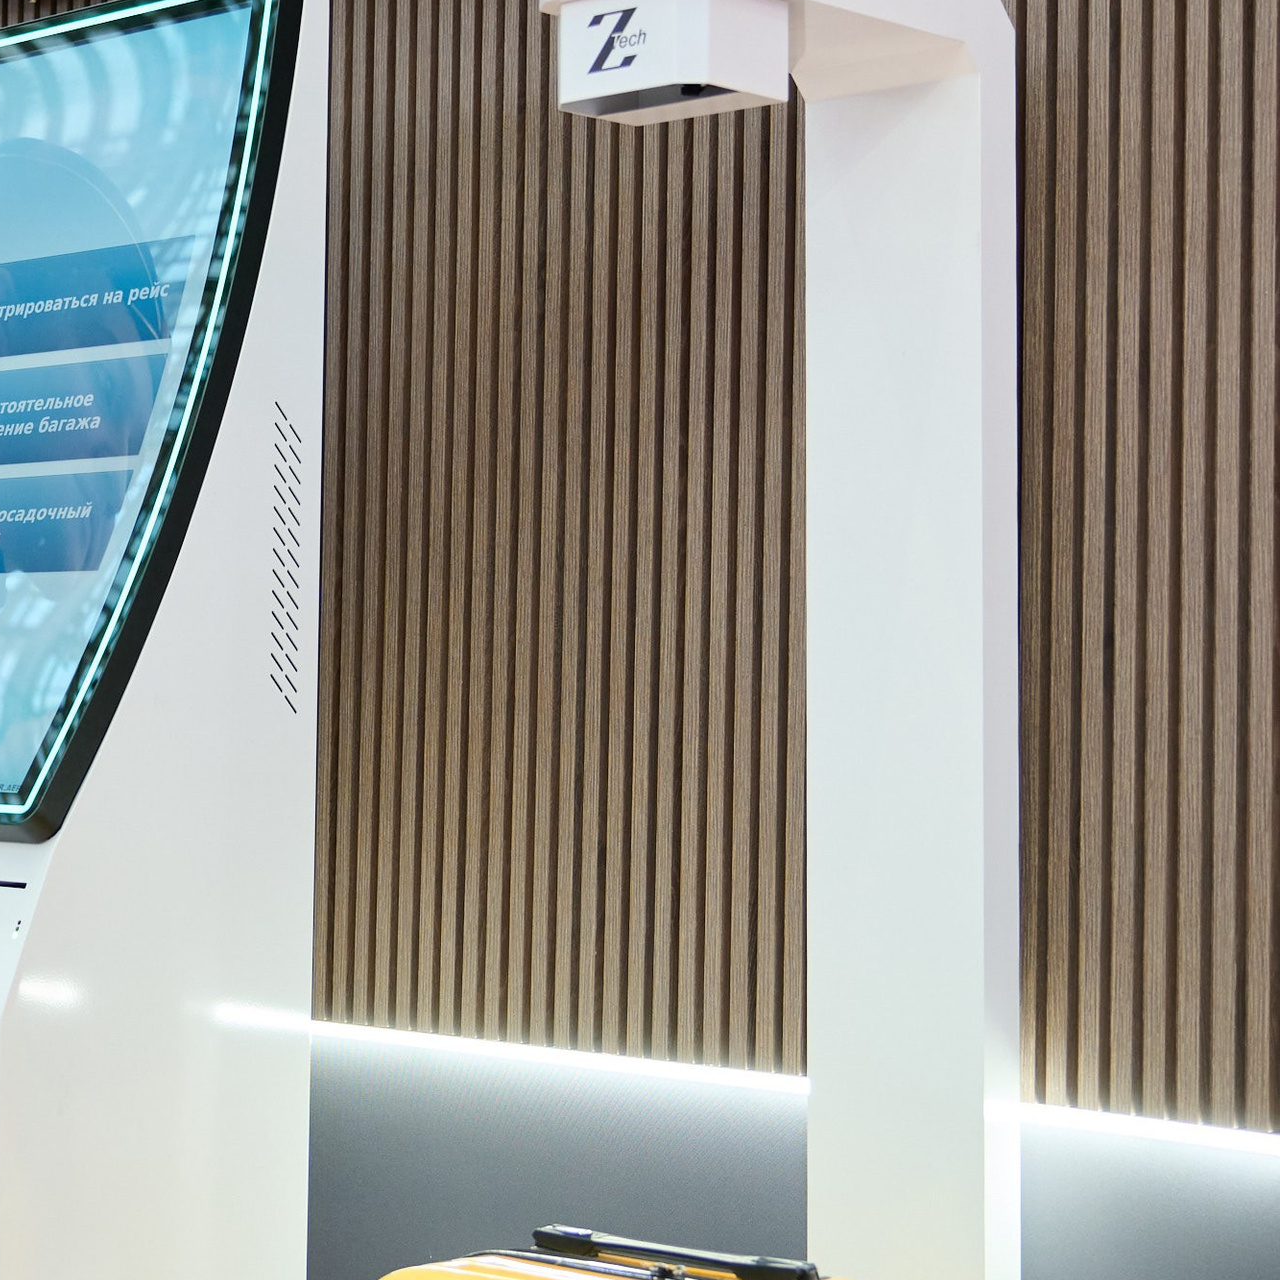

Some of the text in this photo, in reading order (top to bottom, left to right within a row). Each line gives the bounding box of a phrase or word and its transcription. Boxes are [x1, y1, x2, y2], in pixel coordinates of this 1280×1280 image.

[102, 288, 124, 305] на
[127, 280, 171, 306] рейс
[39, 415, 102, 434] багажа
